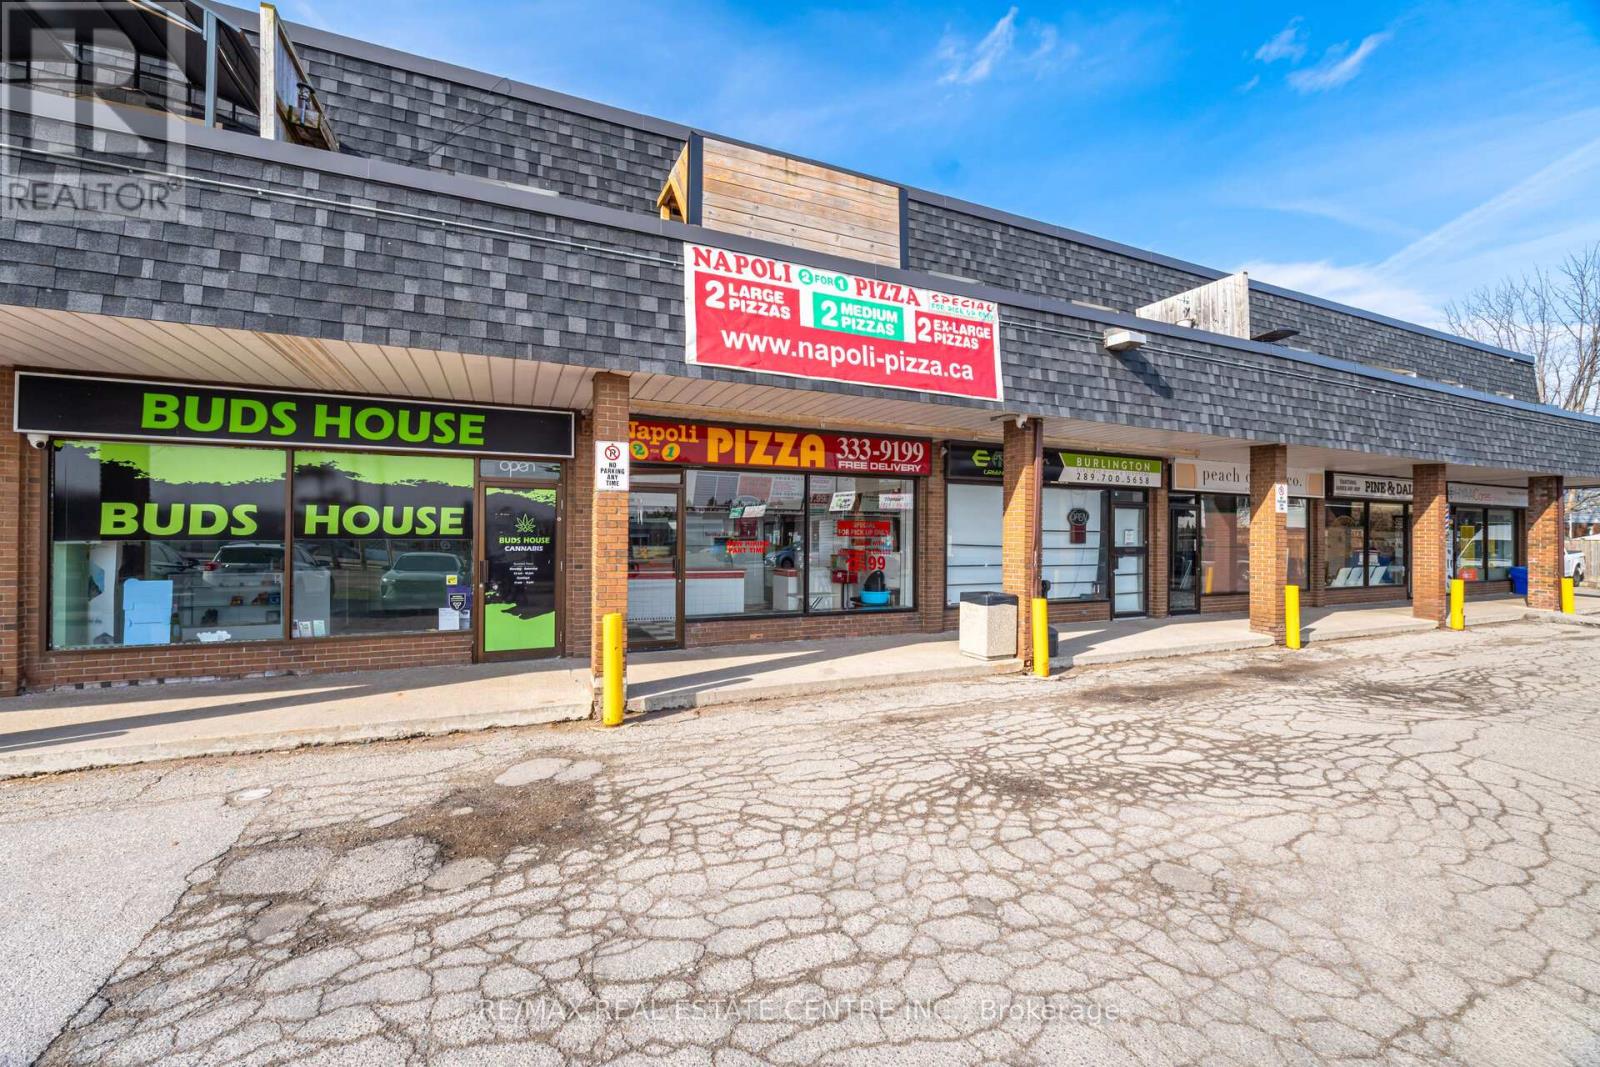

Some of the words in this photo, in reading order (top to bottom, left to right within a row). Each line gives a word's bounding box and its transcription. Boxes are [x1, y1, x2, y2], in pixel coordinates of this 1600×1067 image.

[692, 246, 793, 283] NAPOLI
[801, 270, 812, 284] 2
[815, 275, 834, 287] FOR
[854, 277, 921, 307] PIZZA
[705, 280, 725, 310] 2
[728, 283, 784, 305] LARGE
[931, 294, 993, 313] SPECIAL
[728, 297, 791, 320] PIZZAS
[821, 300, 839, 327] 2
[841, 302, 898, 323] MEDIUM
[841, 316, 895, 336] PIZZAS
[917, 317, 932, 343] 2
[933, 319, 991, 340] EX-LARGE
[934, 331, 979, 350] PIZZAS
[720, 329, 974, 381] www.napoli-pizza.ca
[141, 392, 297, 437] BUDS
[314, 404, 486, 446] HOUSE
[633, 443, 646, 456] 2
[707, 427, 826, 469] PIZZA
[836, 437, 924, 463] 333-9199
[500, 460, 536, 478] open
[600, 467, 625, 475] PARKING
[838, 460, 869, 470] FREE
[869, 462, 922, 473] DELIVERY
[1076, 457, 1151, 472] BURLINGTON
[1076, 472, 1150, 485] 289.700.5658
[1203, 467, 1240, 486] peach
[1365, 481, 1386, 494] PINE
[1387, 481, 1396, 496] &
[99, 502, 259, 537] BUDS
[304, 504, 465, 537] HOUSE
[1071, 510, 1089, 522] OPEN
